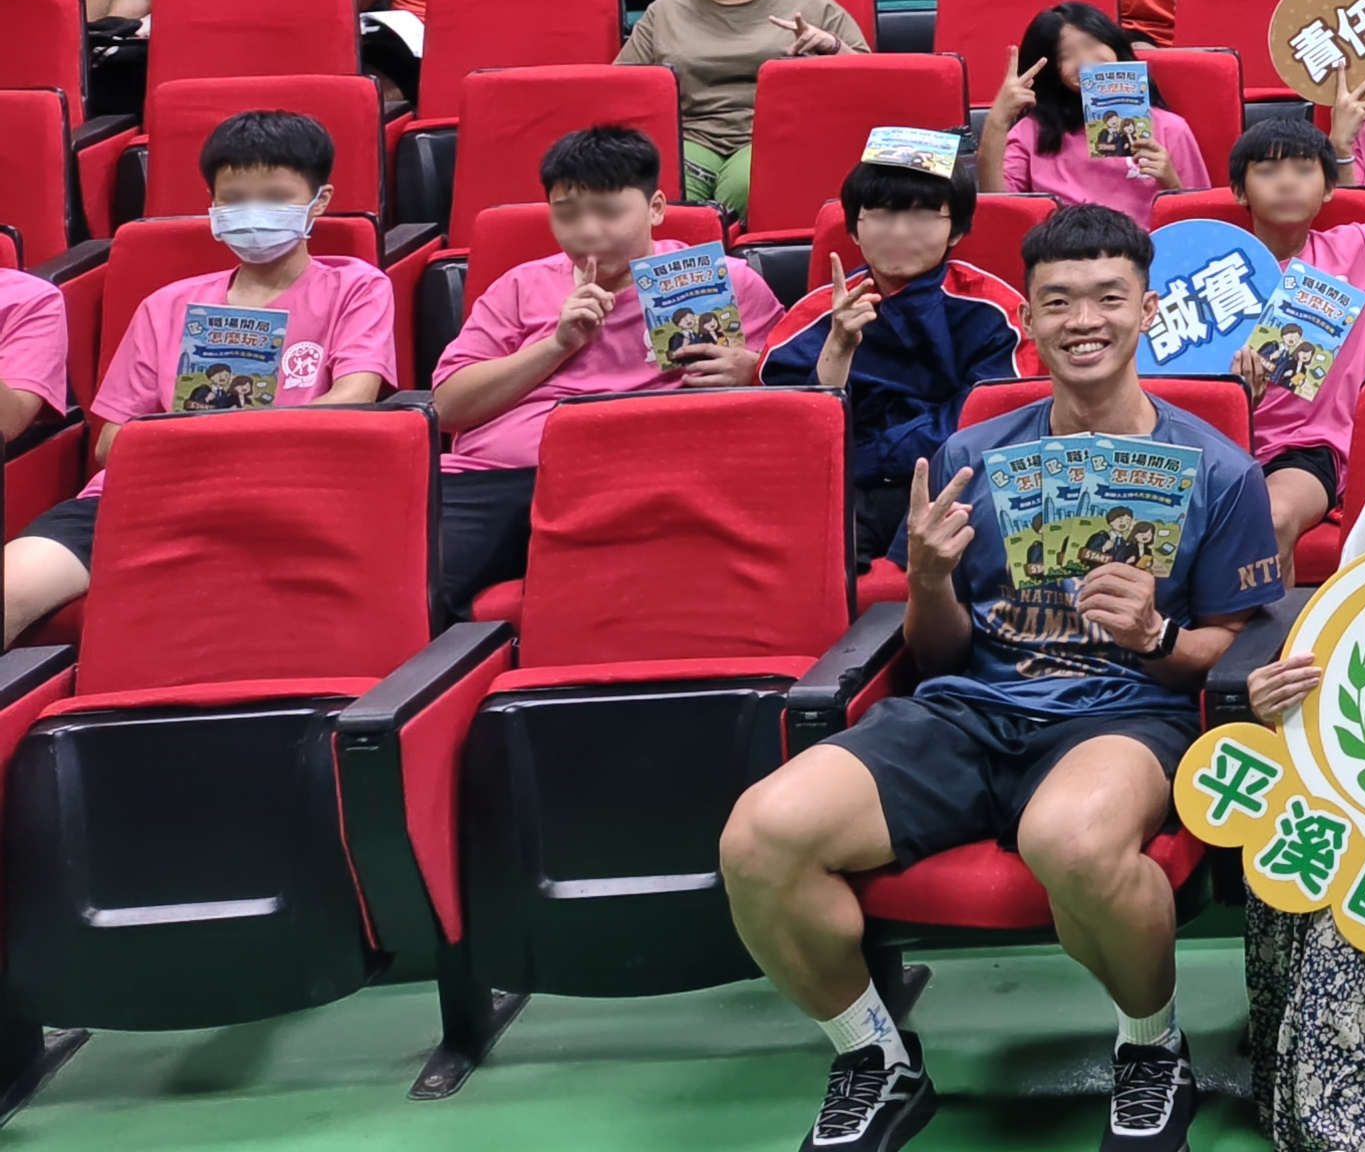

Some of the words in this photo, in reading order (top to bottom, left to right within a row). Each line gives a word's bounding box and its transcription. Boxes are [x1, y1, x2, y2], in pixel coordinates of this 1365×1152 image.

[652, 255, 711, 277] 職場開局
[658, 270, 714, 293] 怎麼玩?
[1302, 276, 1349, 308] 職場開局
[1148, 251, 1262, 362] 誠實
[1297, 290, 1343, 320] 怎麼玩?
[208, 317, 270, 333] 職場開局
[207, 332, 269, 348] 怎麼玩?
[1113, 451, 1181, 472] 職場開局
[1111, 468, 1177, 488] 怎麼玩?
